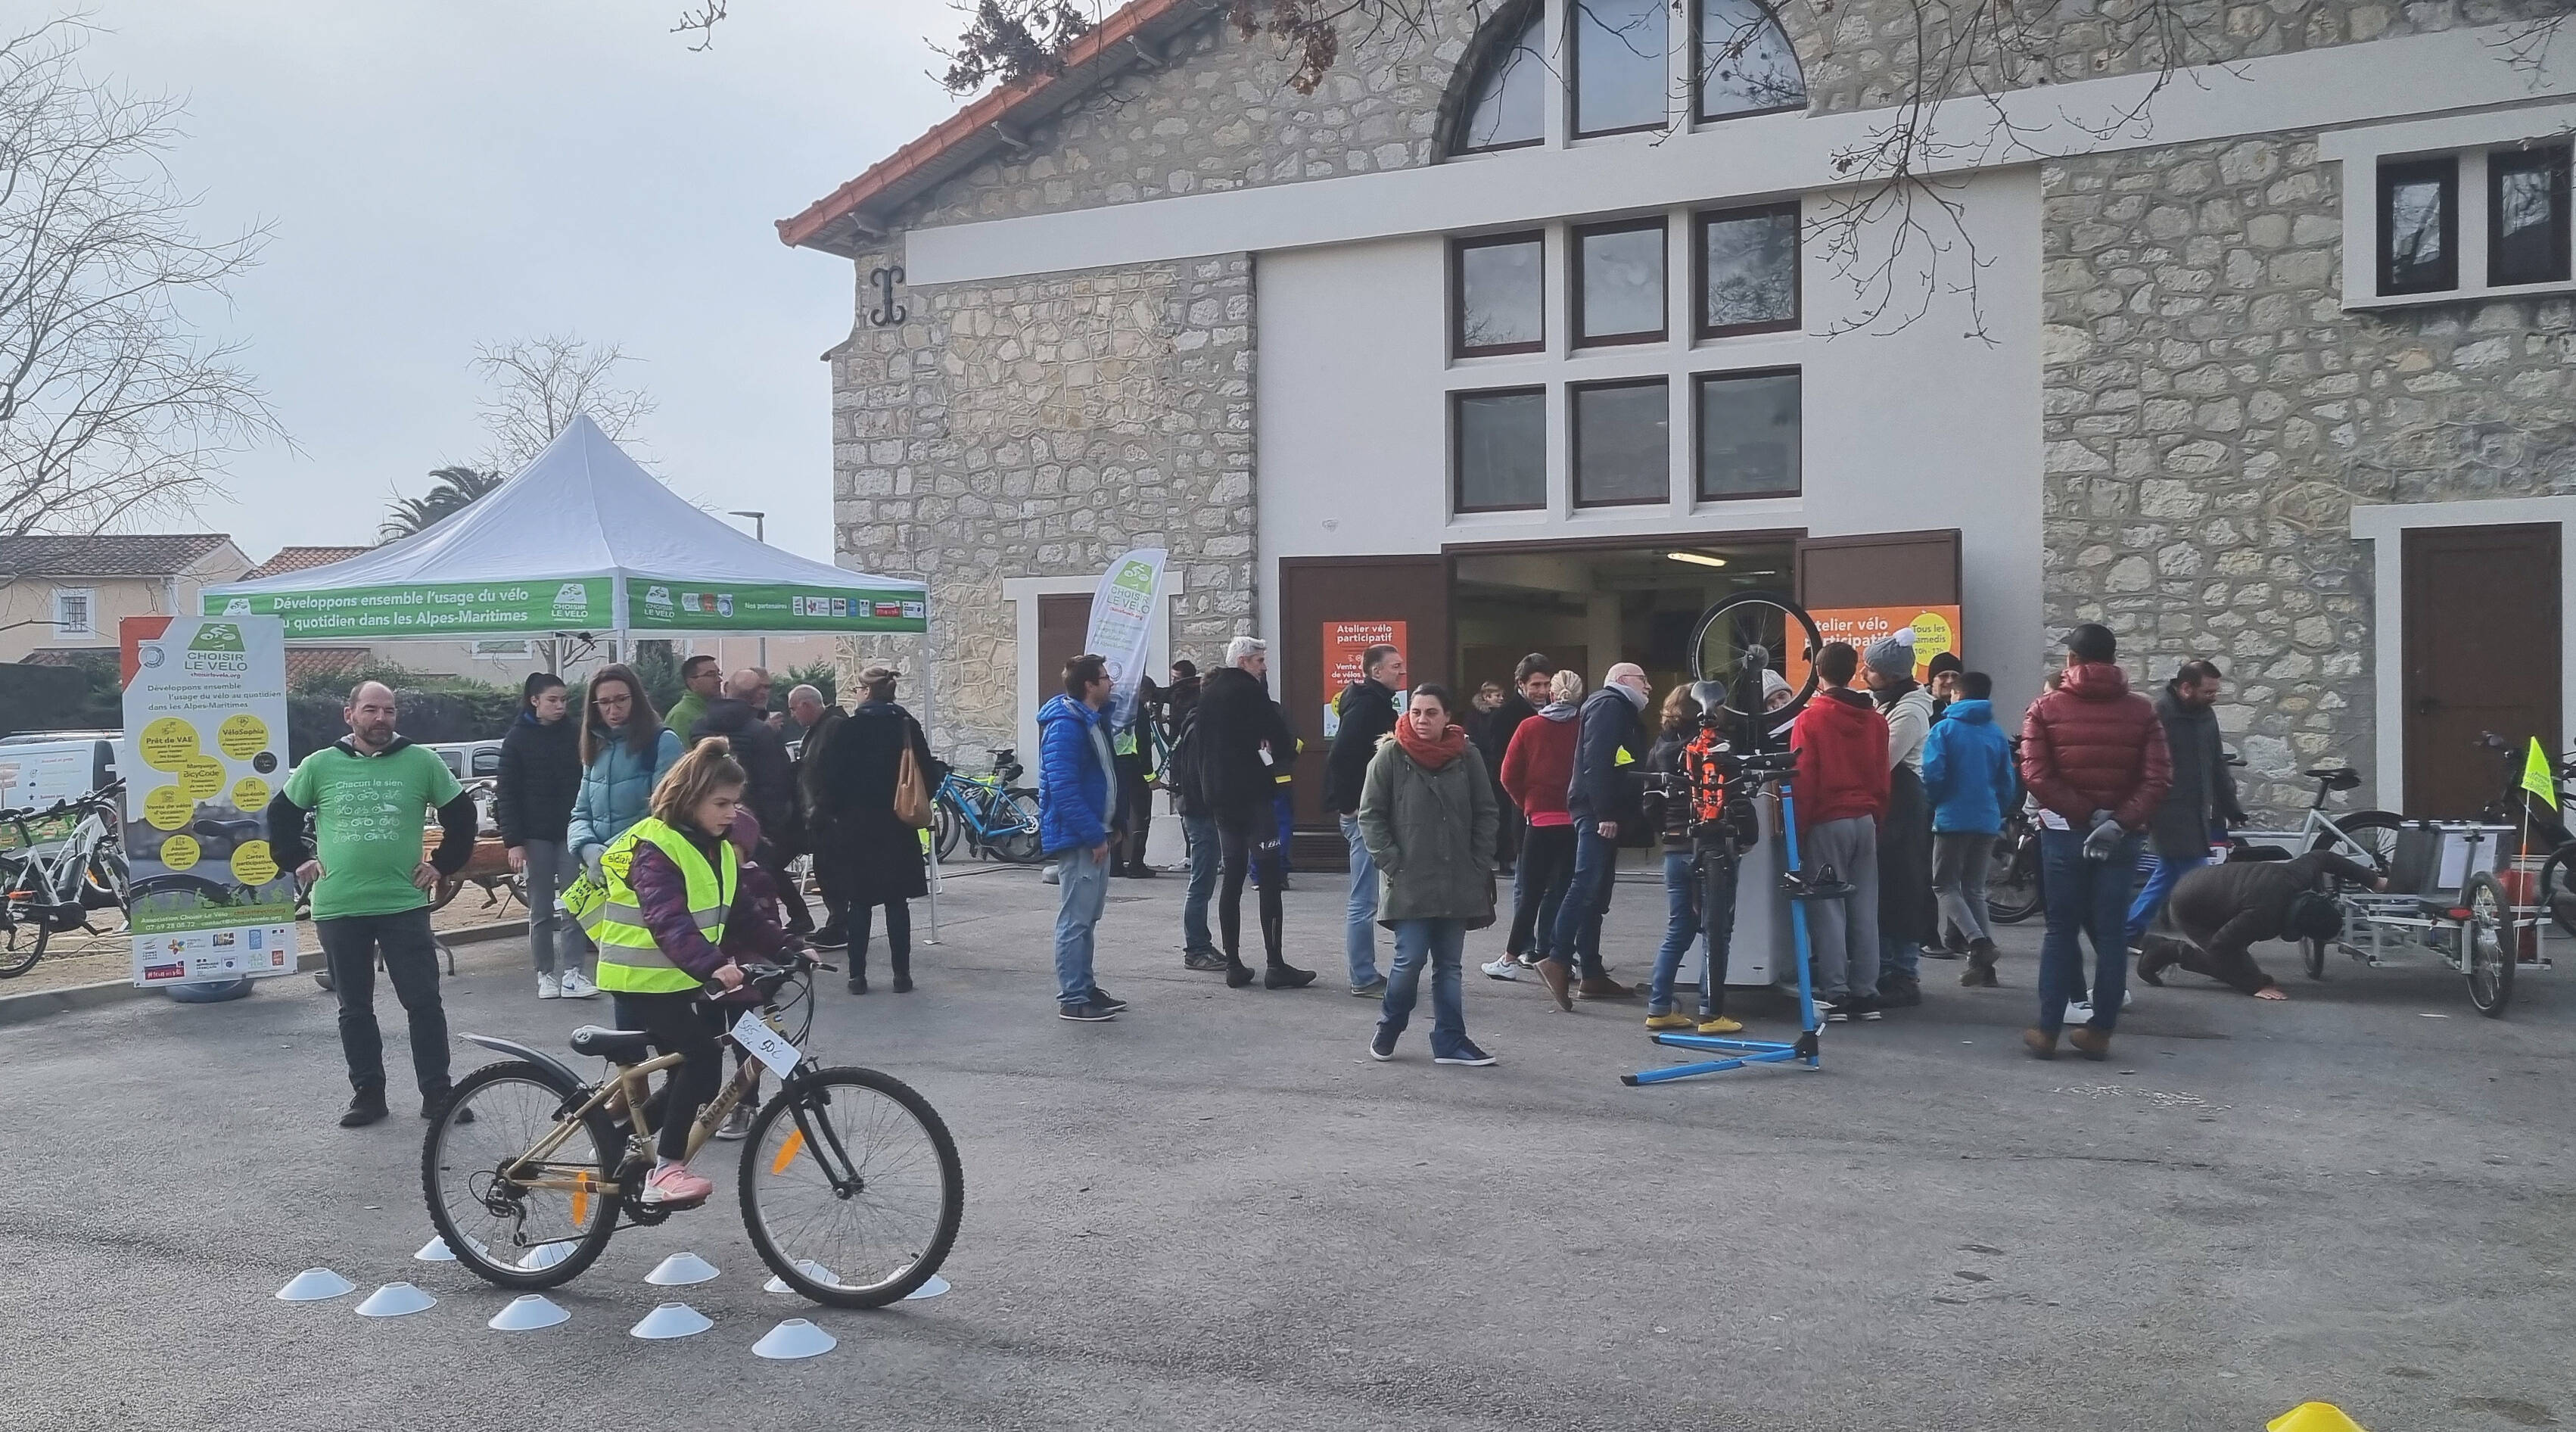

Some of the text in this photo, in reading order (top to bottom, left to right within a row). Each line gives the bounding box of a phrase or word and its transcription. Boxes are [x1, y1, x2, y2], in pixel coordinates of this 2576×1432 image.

[273, 587, 529, 612] Développons ensemble l'usage du vélo
[1106, 594, 1120, 605] LE
[1110, 586, 1150, 603] CHOISIR
[294, 614, 356, 630] quotidien
[359, 612, 390, 626] dans
[394, 612, 412, 625] les
[416, 609, 528, 627] Alpes-Maritimes
[655, 610, 675, 618] VELO
[1336, 623, 1393, 634] Atelier vélo
[1815, 616, 1889, 632] telier vélo
[1912, 623, 1946, 633] Tous les
[1336, 633, 1393, 644] participatif
[1914, 634, 1946, 643] amedis
[187, 652, 244, 661] CHOISIR
[185, 661, 248, 672] LE VELO
[148, 682, 241, 693] Développons ensemble
[169, 693, 198, 702] l'usage
[200, 692, 210, 700] du
[244, 691, 282, 700] quotidien
[148, 703, 168, 711] dans
[183, 701, 248, 711] Alpes-Maritimes
[335, 780, 372, 789] Chacun
